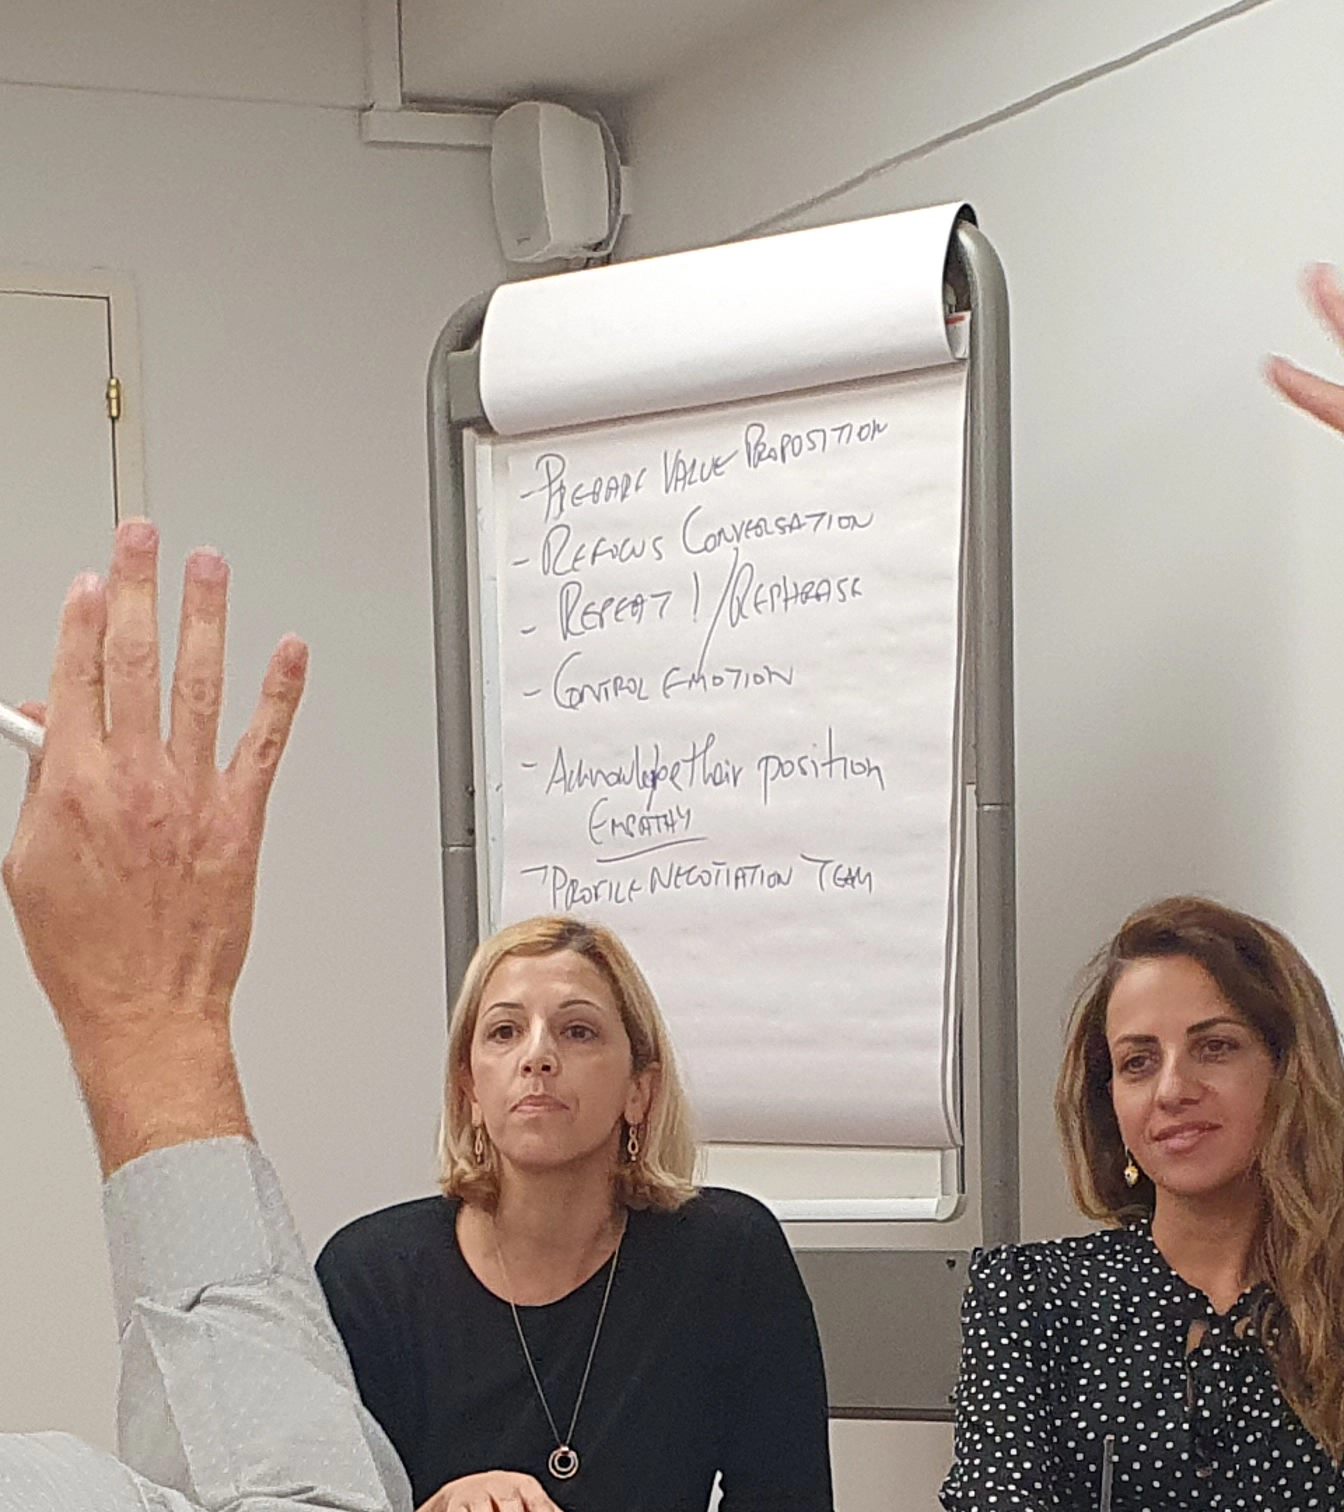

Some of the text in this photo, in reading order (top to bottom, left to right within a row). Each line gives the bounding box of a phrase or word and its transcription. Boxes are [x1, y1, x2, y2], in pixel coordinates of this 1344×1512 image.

[663, 448, 739, 495] VALUE
[682, 504, 875, 555] CONVERSATION
[558, 580, 673, 641] REPEAT
[661, 664, 797, 700] EMOTION
[756, 726, 886, 806] position
[588, 797, 692, 845] EMPATHY
